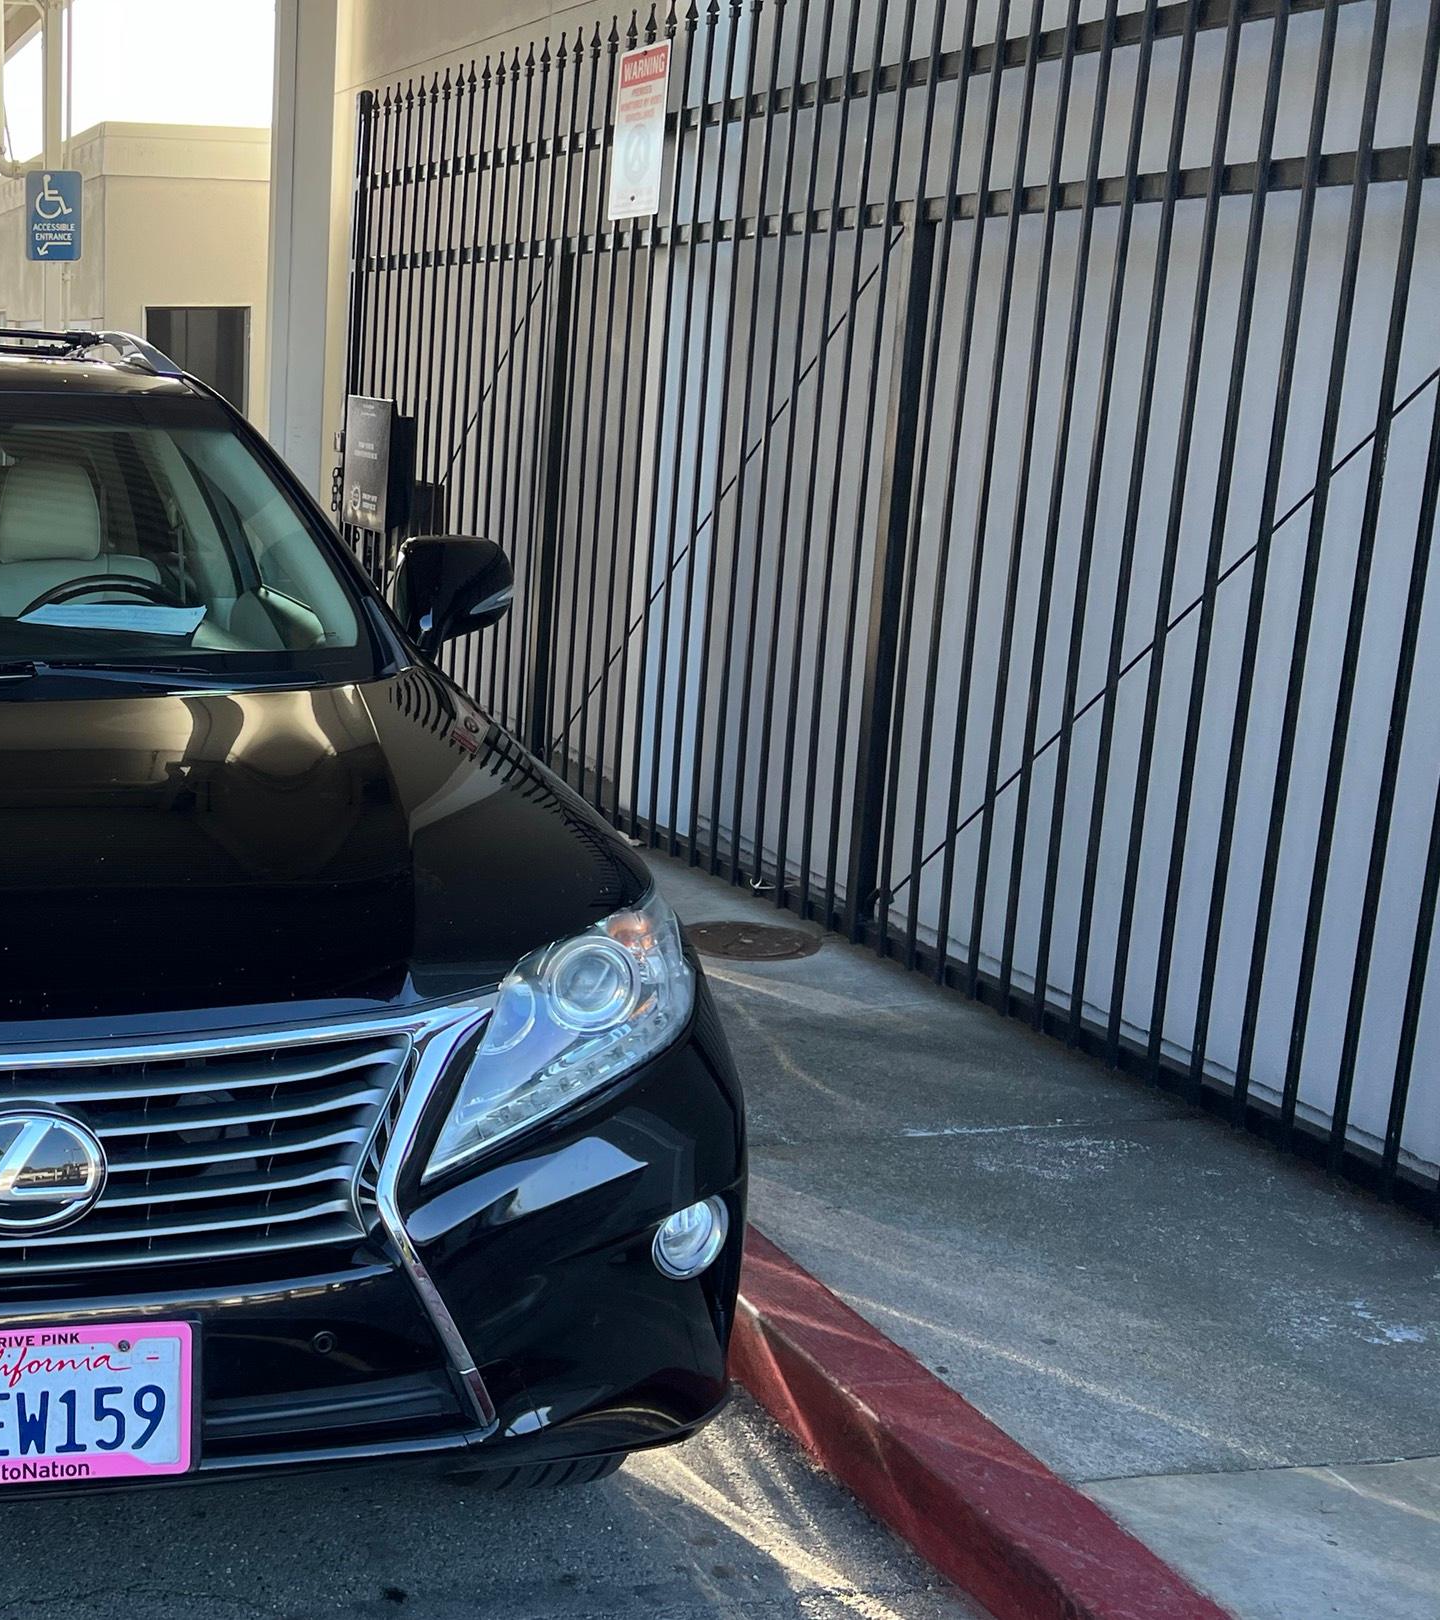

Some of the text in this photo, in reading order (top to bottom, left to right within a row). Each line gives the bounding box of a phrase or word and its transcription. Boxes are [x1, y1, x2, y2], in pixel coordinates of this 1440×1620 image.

[623, 53, 666, 83] WARNING
[33, 223, 75, 231] ACCESSIBLE
[41, 1332, 80, 1346] PINK
